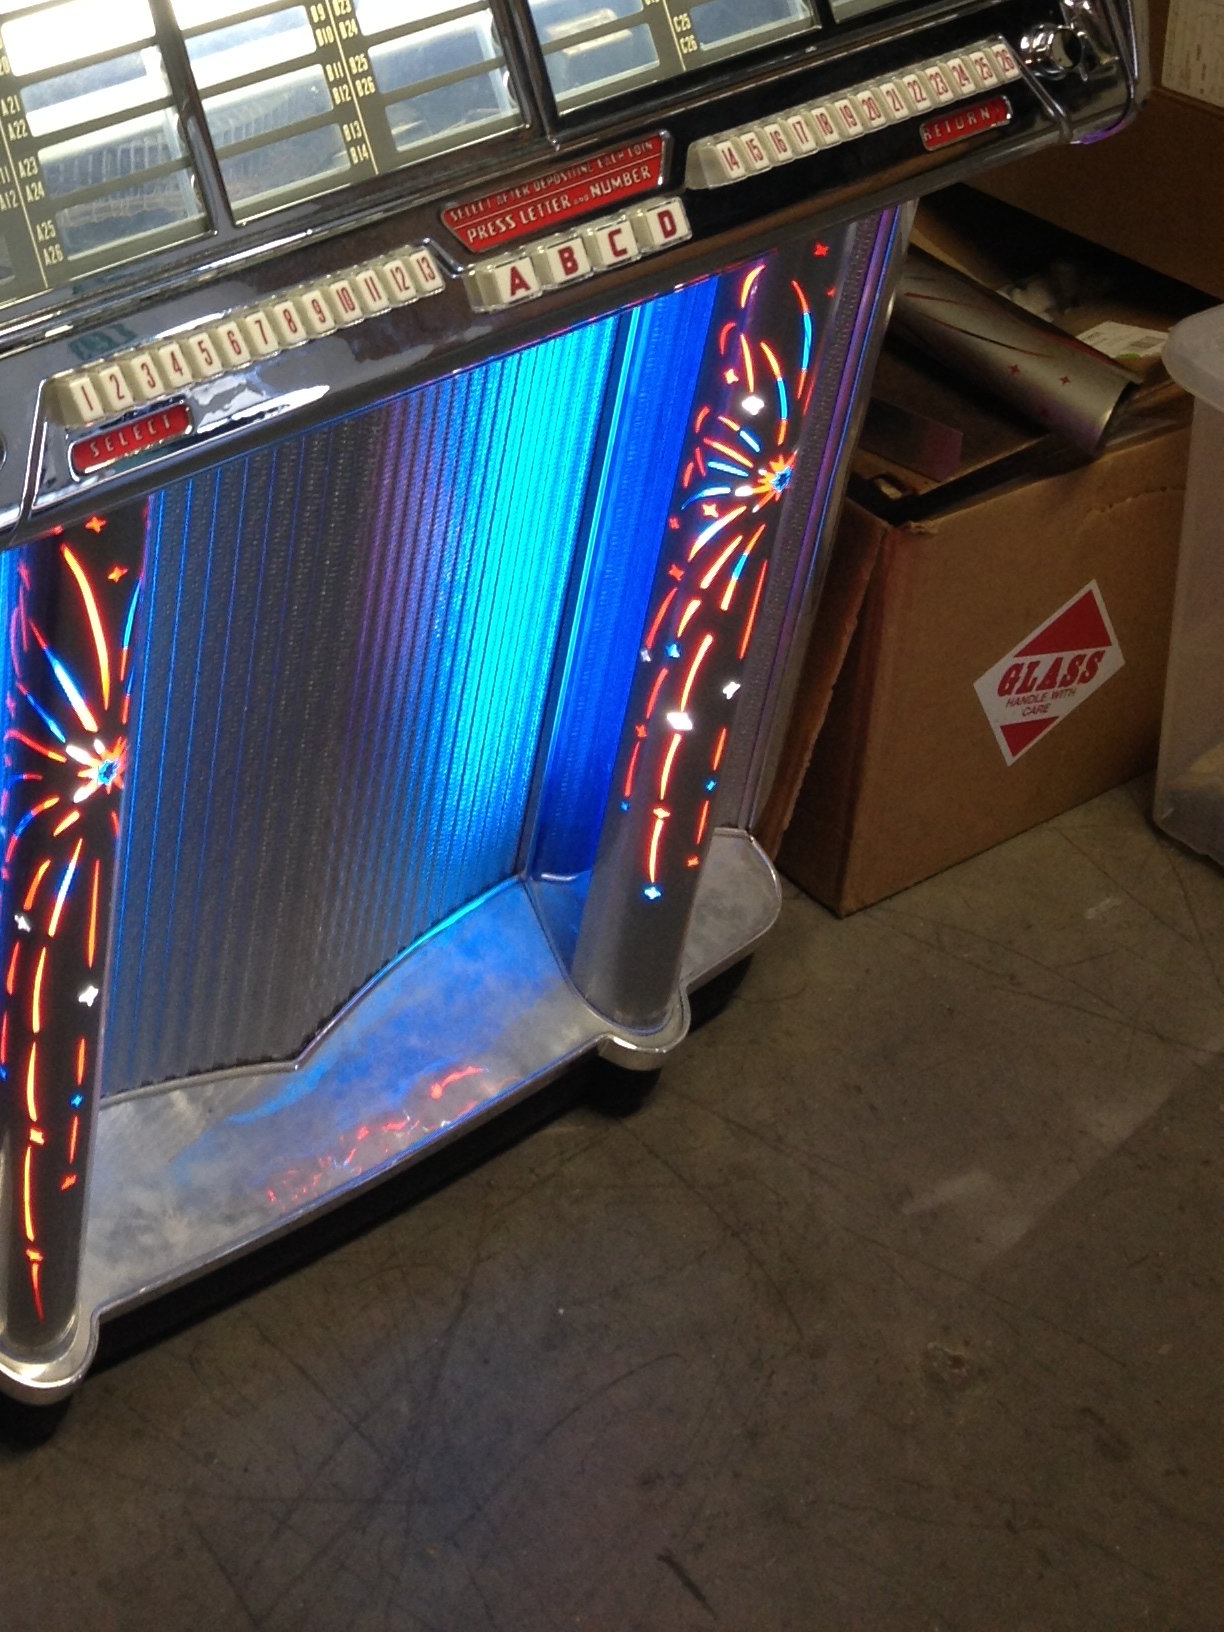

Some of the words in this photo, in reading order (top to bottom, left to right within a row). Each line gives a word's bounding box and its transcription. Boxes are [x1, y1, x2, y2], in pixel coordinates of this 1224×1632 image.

[673, 13, 691, 32] C25
[680, 35, 697, 54] C26
[1, 94, 20, 116] A21
[722, 147, 740, 171] 14
[746, 138, 763, 162] 15
[770, 130, 788, 154] 16
[792, 121, 808, 144] 17
[816, 112, 833, 135] 18
[840, 105, 857, 128] 19
[862, 97, 881, 121] 20
[886, 89, 904, 112] 21
[907, 80, 926, 103] 22
[929, 72, 949, 96] 23
[952, 64, 969, 87] 24
[975, 57, 993, 81] 25
[995, 50, 1014, 72] 26
[8, 119, 28, 141] A22
[924, 107, 990, 141] RETURN
[18, 156, 38, 179] A23
[0, 190, 18, 211] A12
[26, 181, 45, 203] A24
[467, 214, 516, 243] PRESS
[519, 194, 571, 224] LETTER
[590, 166, 651, 198] NUMBER
[36, 220, 56, 242] A25
[43, 244, 63, 266] A26
[510, 267, 530, 296] A
[558, 246, 579, 275] B
[608, 228, 627, 258] C
[657, 210, 677, 238] D
[81, 386, 93, 411] 1
[109, 374, 124, 400] 2
[141, 362, 156, 389] 3
[171, 351, 184, 379] 4
[198, 340, 213, 365] 5
[227, 330, 242, 355] 6
[254, 320, 268, 345] 7
[283, 309, 297, 334] 8
[312, 299, 326, 323] 9
[336, 287, 355, 313] 10
[365, 277, 381, 302] 11
[390, 266, 410, 292] 12
[417, 256, 436, 282] 13
[90, 414, 170, 458] SELECT
[997, 650, 1105, 697] GLASS
[1006, 692, 1048, 708] HANDLE
[1051, 688, 1077, 700] WITH
[1022, 703, 1051, 717] CARE
